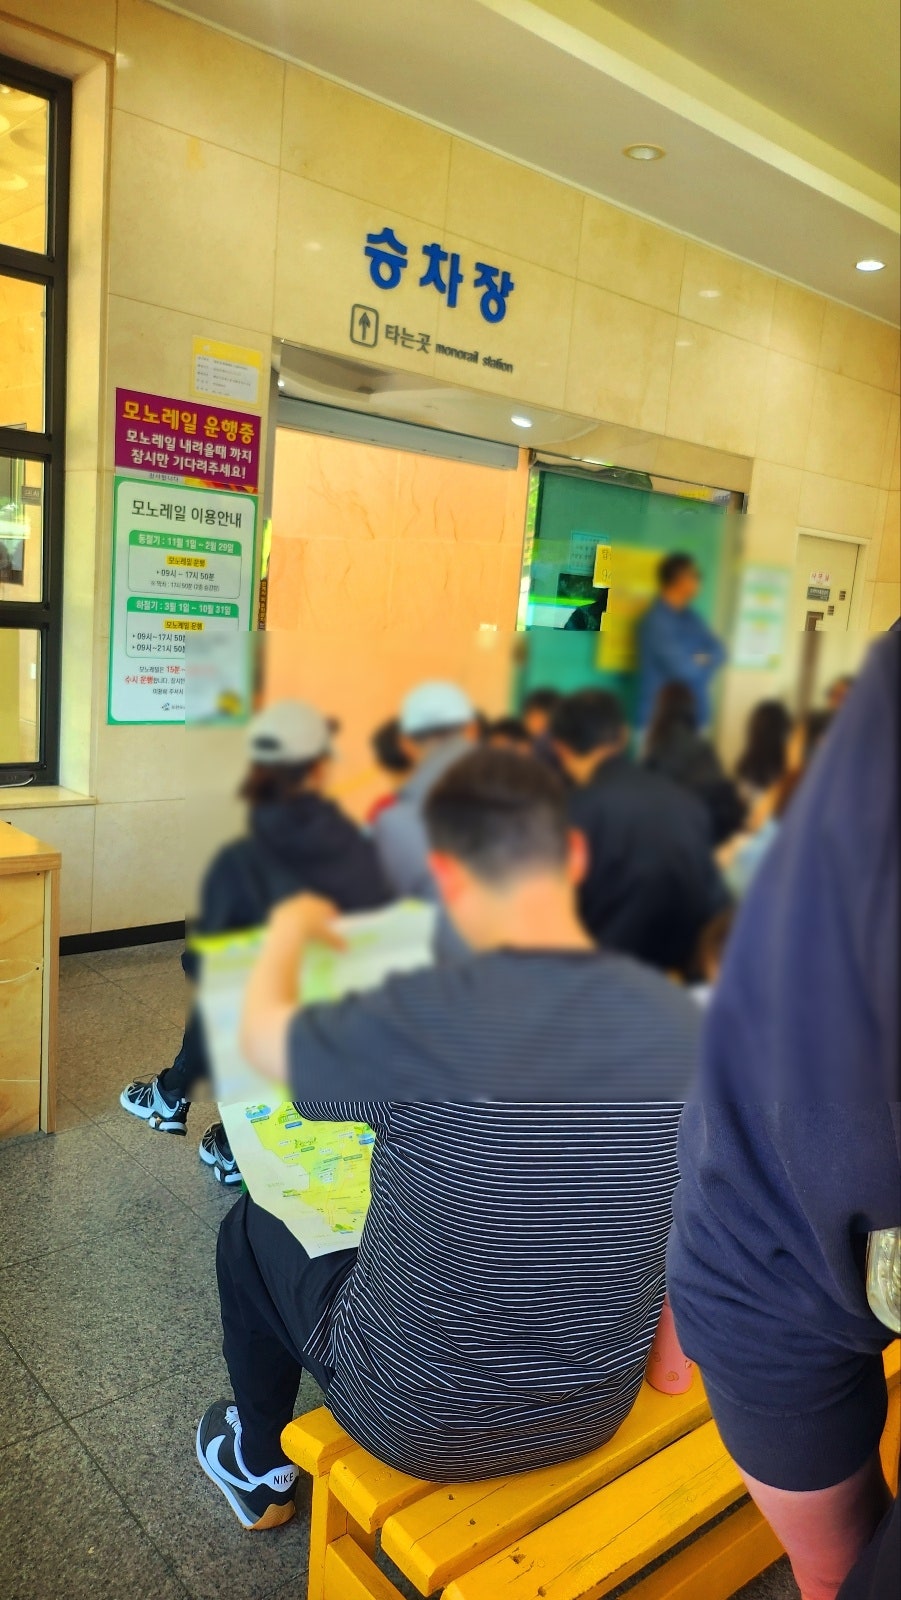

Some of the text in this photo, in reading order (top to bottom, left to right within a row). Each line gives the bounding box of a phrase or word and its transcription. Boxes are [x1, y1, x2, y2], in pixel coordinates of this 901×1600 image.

[364, 227, 515, 324] 승차장
[384, 324, 431, 354] 타는곳
[435, 342, 514, 374] monorail station
[122, 400, 255, 445] 모노레일 운행중
[126, 429, 252, 464] 모노레일 내려올때 까지
[131, 448, 246, 479] 잠시만 기다려주세요!
[131, 499, 242, 529] 모노레일 이용안내
[138, 533, 160, 546] 동절기
[167, 537, 184, 549] 11월
[185, 539, 197, 550] 1일
[205, 541, 217, 552] 2월
[161, 569, 177, 578] 09시
[185, 571, 199, 580] 17시
[200, 572, 215, 582] 50분
[167, 556, 192, 567] 모노레일
[136, 600, 158, 611] 하절기
[164, 602, 177, 613] 3월
[178, 603, 190, 614] 1일
[199, 604, 214, 615] 10월
[215, 605, 232, 616] 31일
[165, 620, 190, 630] 모노레일
[273, 1472, 294, 1485] NIKE
